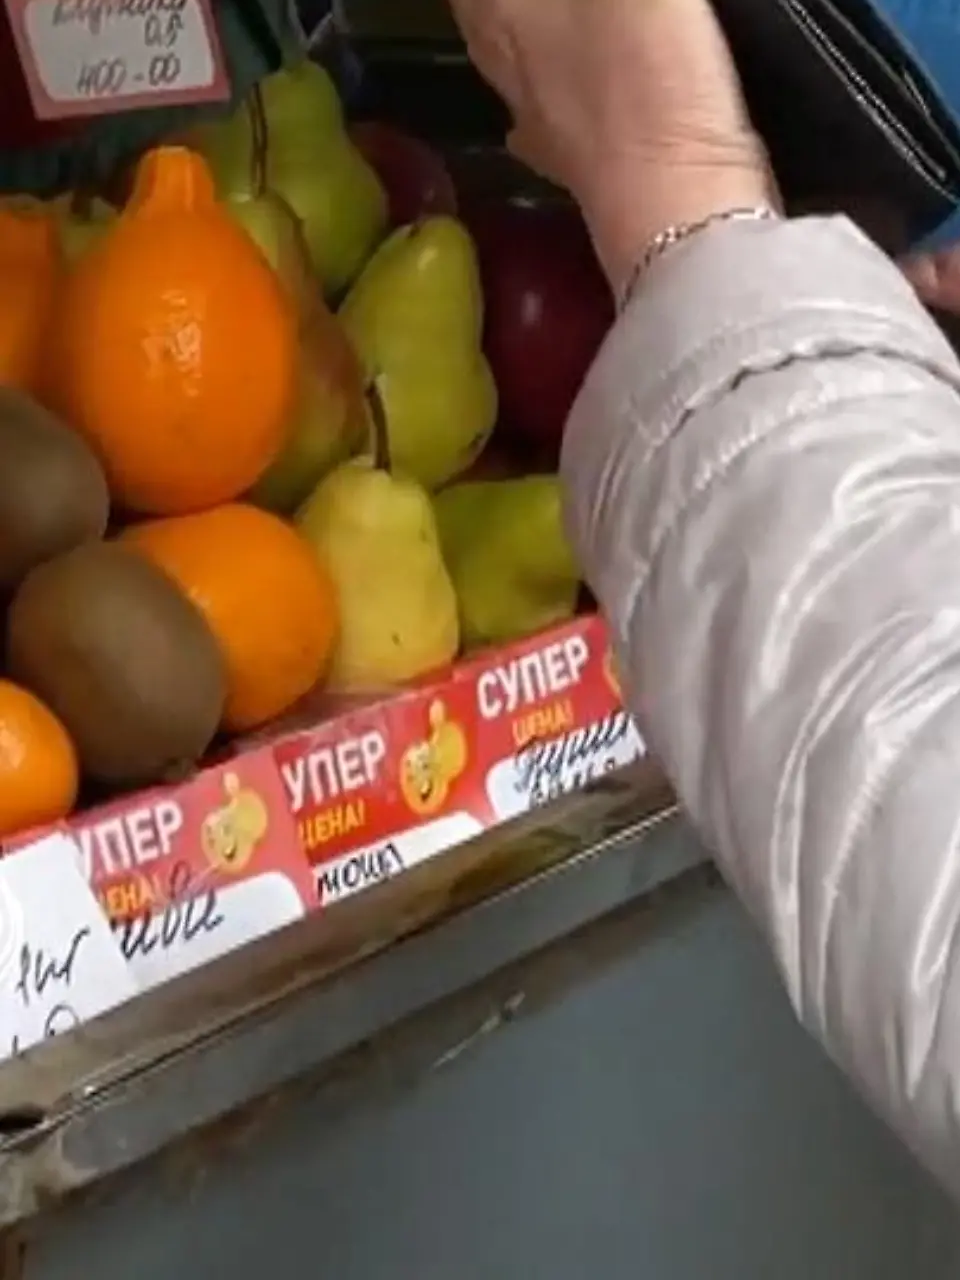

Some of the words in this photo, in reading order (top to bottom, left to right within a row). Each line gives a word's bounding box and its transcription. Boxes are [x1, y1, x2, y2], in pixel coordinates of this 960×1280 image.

[477, 635, 590, 719] СУПЕР
[512, 698, 574, 746] ЦЕНА!
[281, 730, 386, 812] УПЕР
[77, 800, 183, 883] УПЕР
